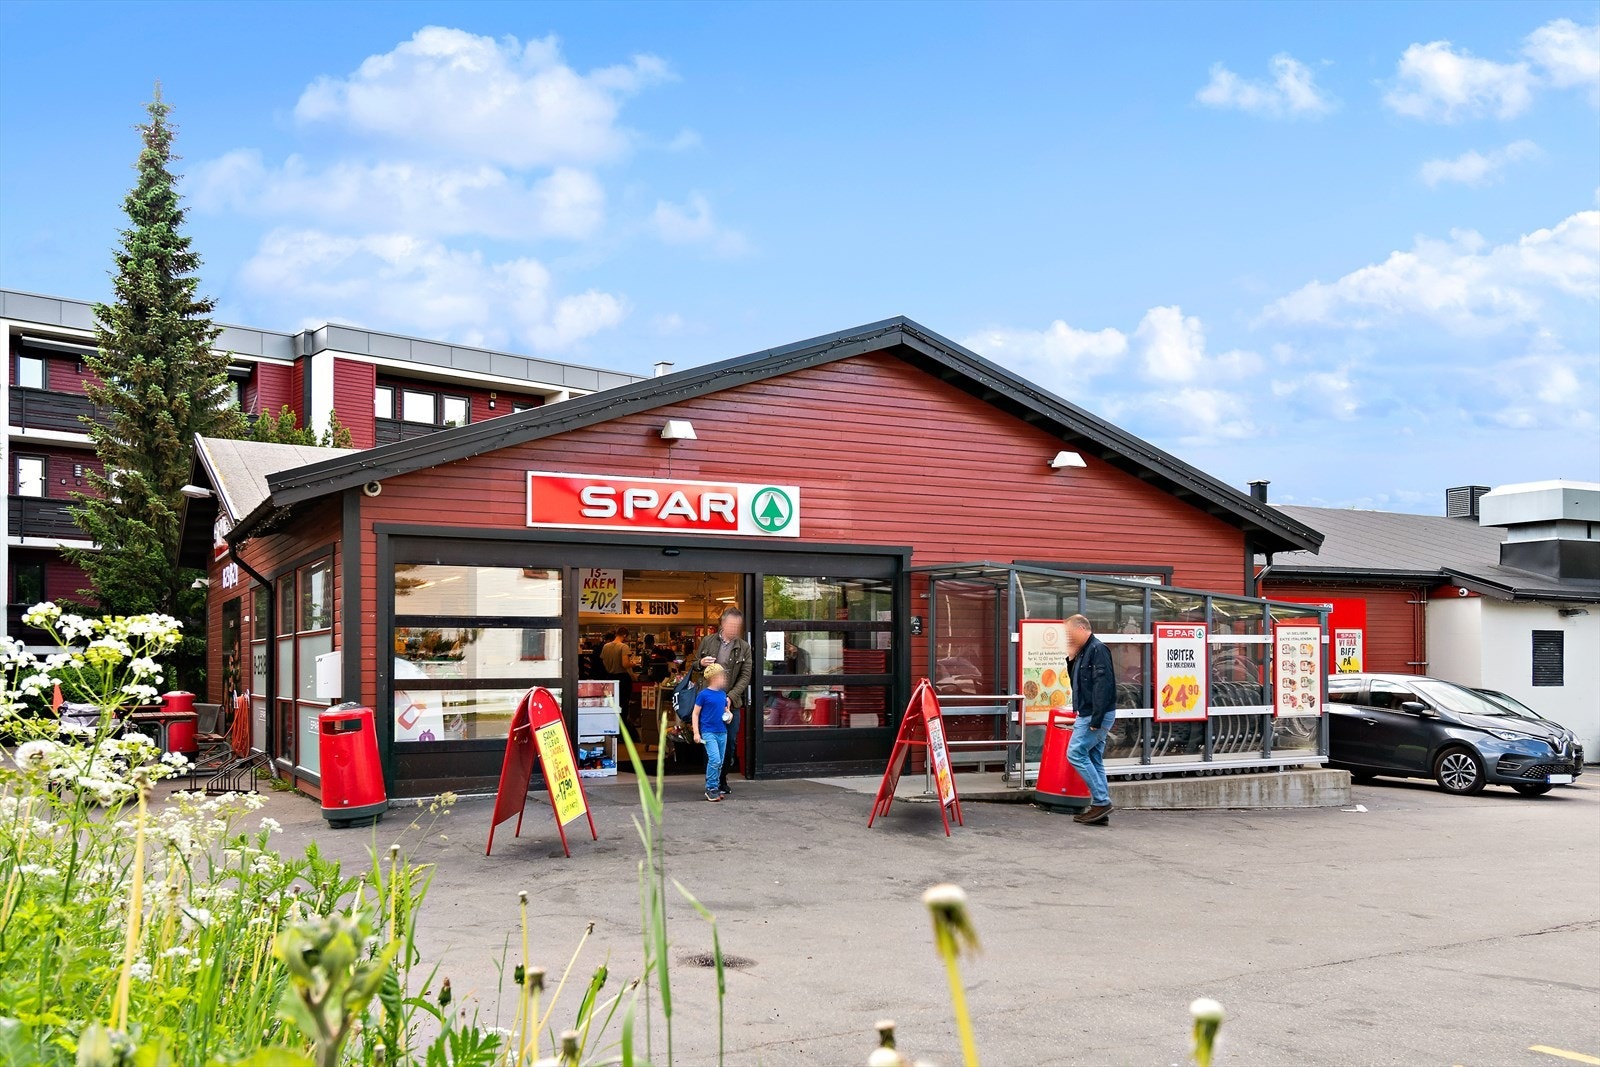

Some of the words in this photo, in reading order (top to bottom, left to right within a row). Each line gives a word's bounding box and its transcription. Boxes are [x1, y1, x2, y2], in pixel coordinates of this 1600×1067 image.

[581, 486, 736, 523] SPAR
[583, 578, 617, 589] KREM
[635, 602, 644, 614] &
[649, 602, 679, 615] BRUS
[1167, 649, 1194, 661] ISBITER
[1341, 648, 1356, 656] BIFF
[1343, 657, 1352, 666] PÅ
[553, 765, 571, 782] KREM
